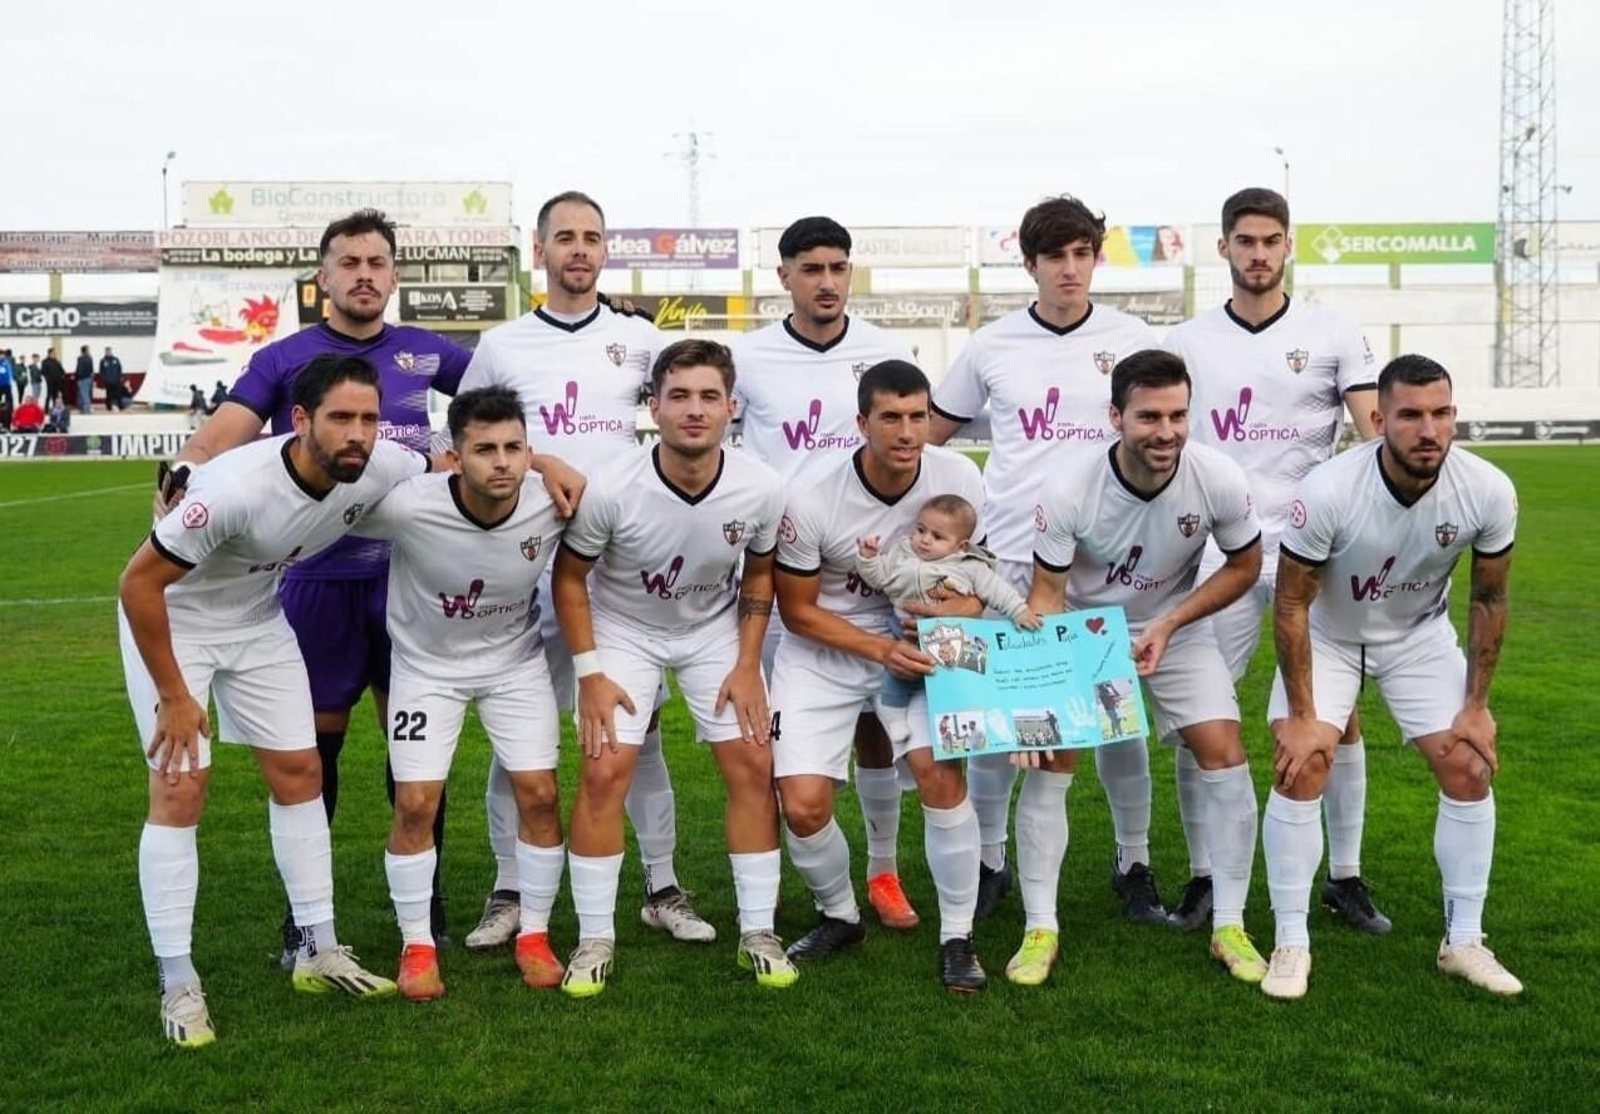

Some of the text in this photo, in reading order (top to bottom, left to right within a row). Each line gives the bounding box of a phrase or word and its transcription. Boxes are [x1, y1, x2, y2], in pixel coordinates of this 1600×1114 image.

[160, 231, 291, 246] POZOBLANCO
[1340, 235, 1476, 252] SERCOMALLA
[202, 248, 220, 262] La
[223, 248, 283, 265] bodega
[286, 251, 295, 265] y
[299, 248, 317, 262] La
[405, 247, 471, 261] LUCMAN
[16, 307, 80, 328] cano
[578, 420, 622, 434] OPTICA
[1056, 428, 1104, 441] OPTICA
[1248, 428, 1301, 441] OPTICA
[393, 710, 427, 741] 22
